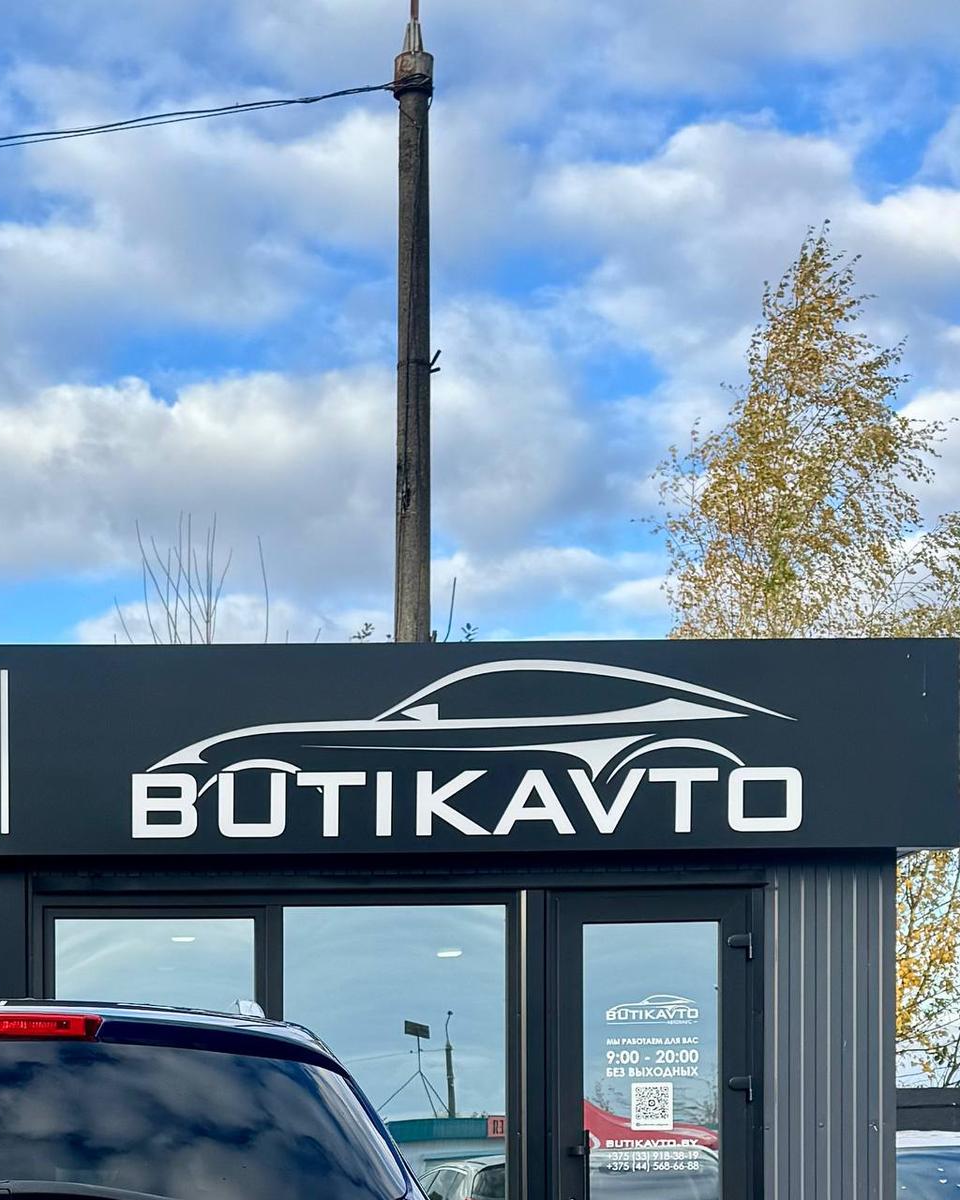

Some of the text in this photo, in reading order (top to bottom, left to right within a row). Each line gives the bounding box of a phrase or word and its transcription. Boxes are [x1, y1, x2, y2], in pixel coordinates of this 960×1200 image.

[131, 766, 803, 839] BUTIKAVTO
[606, 1008, 699, 1021] BUTIKAVTO
[664, 1037, 680, 1045] ДЛЯ
[606, 1051, 639, 1064] 9:00
[655, 1050, 699, 1064] 20:00
[606, 1066, 698, 1078] БЕЗ ВЫХОДНЫХ
[606, 1139, 699, 1148] BUTIKAVTO.BY
[607, 1151, 699, 1162] +375 (33) 918-38-19
[606, 1161, 699, 1172] +375 (44) 568-66-88
